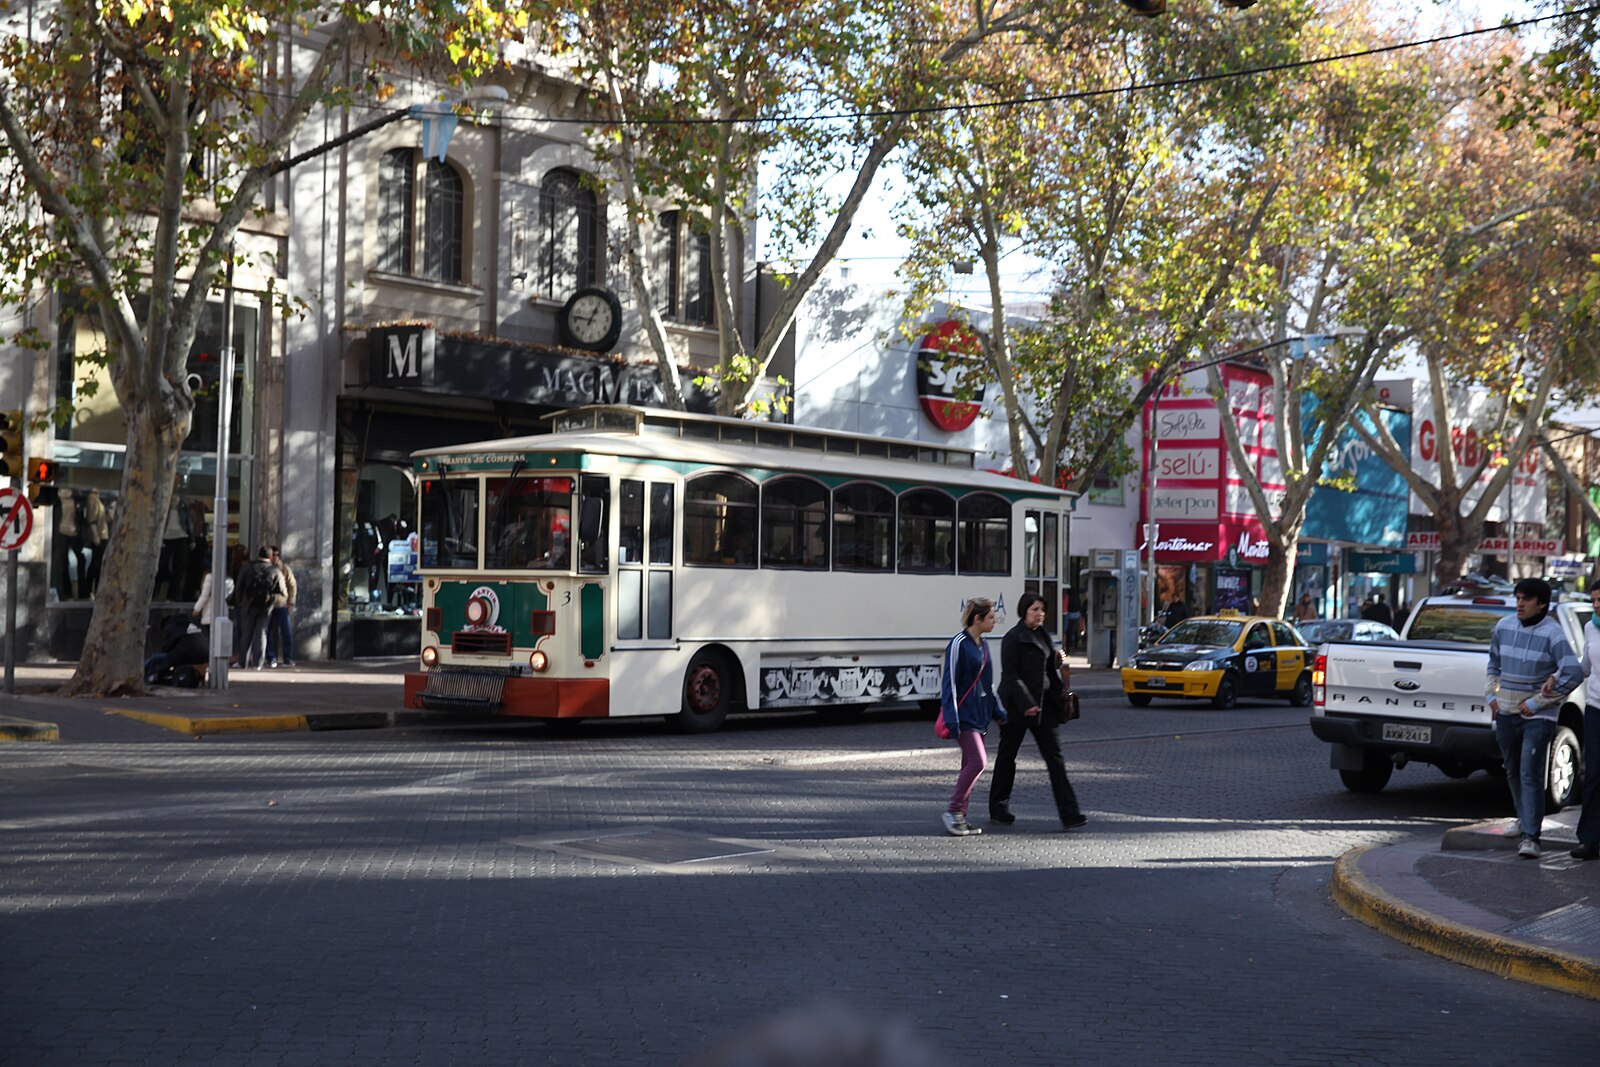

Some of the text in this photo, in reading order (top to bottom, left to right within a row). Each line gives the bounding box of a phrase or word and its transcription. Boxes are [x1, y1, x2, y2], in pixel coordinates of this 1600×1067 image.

[387, 334, 419, 378] M
[486, 454, 526, 463] COMPRAS
[1161, 452, 1205, 476] selú
[561, 591, 571, 607] 3
[1333, 693, 1485, 713] RANGER
